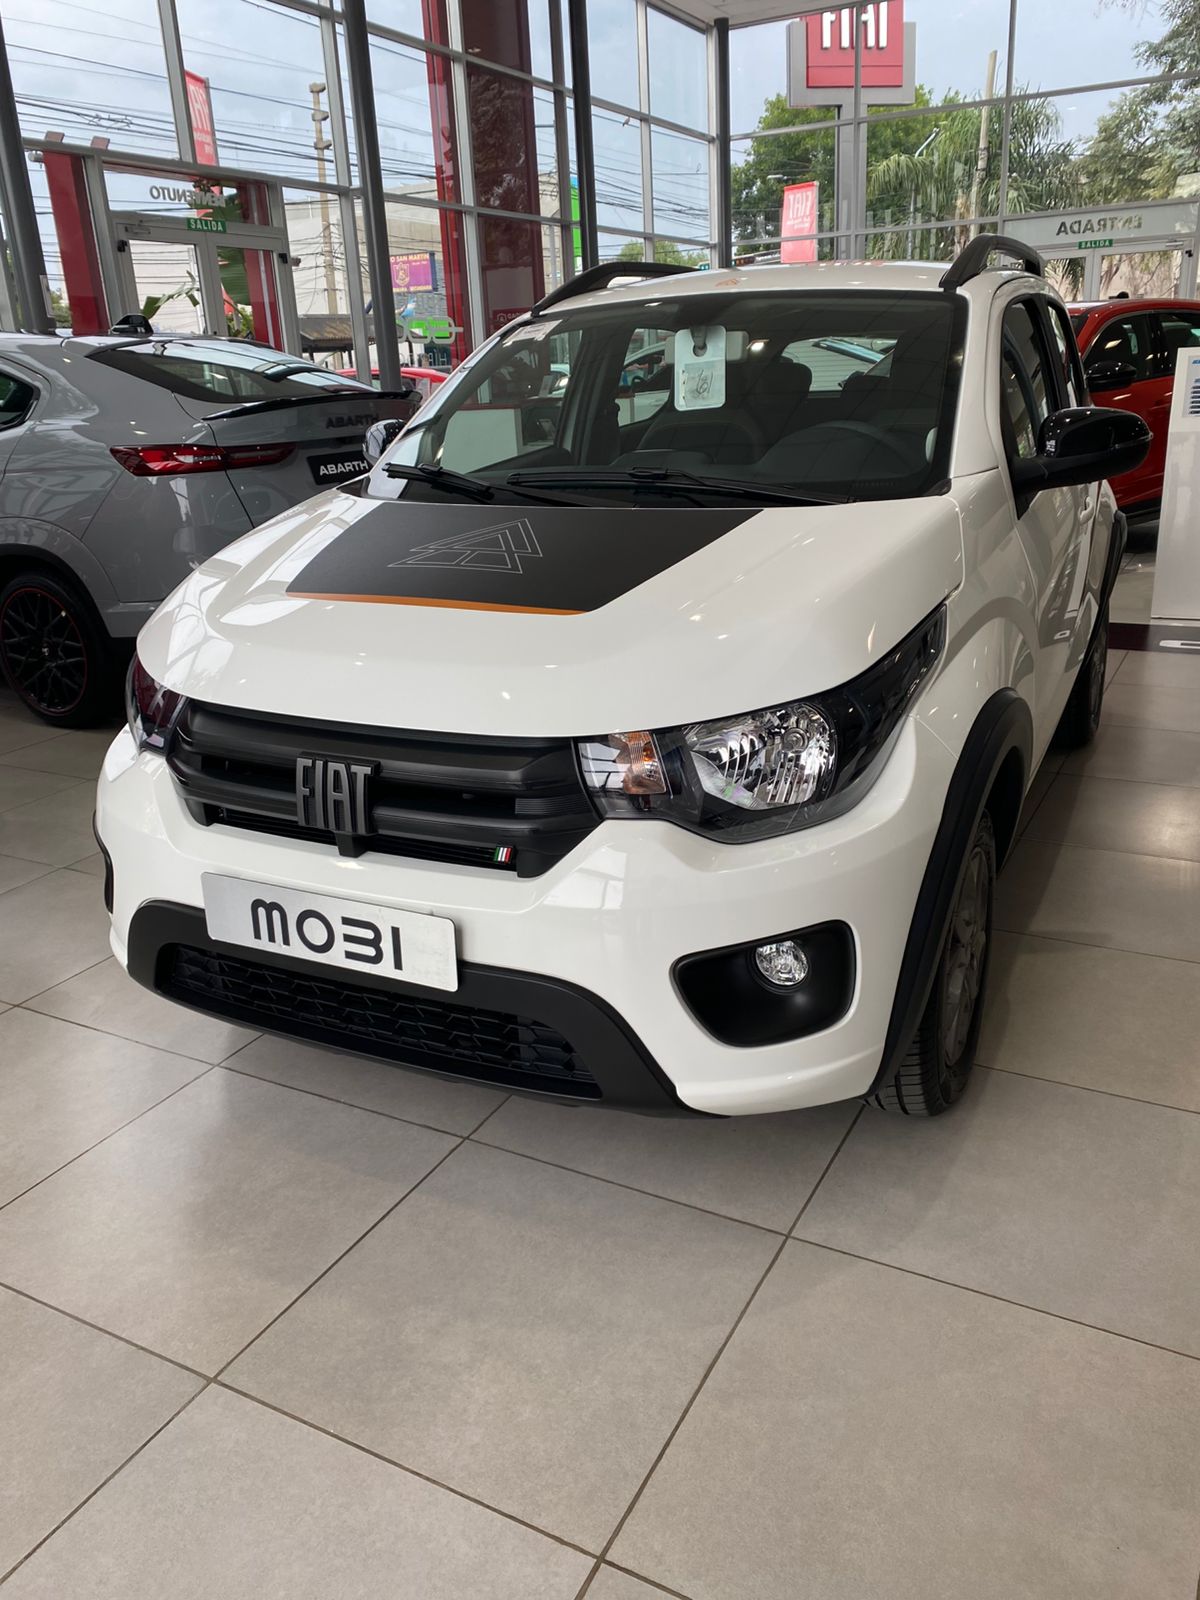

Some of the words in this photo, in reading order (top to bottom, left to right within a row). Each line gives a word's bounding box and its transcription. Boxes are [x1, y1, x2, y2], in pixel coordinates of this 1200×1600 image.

[190, 219, 223, 231] SALIDA
[1081, 240, 1110, 248] SALIDA
[319, 460, 369, 476] ABARTH
[296, 757, 372, 835] FIAT
[250, 898, 404, 971] MOBI
